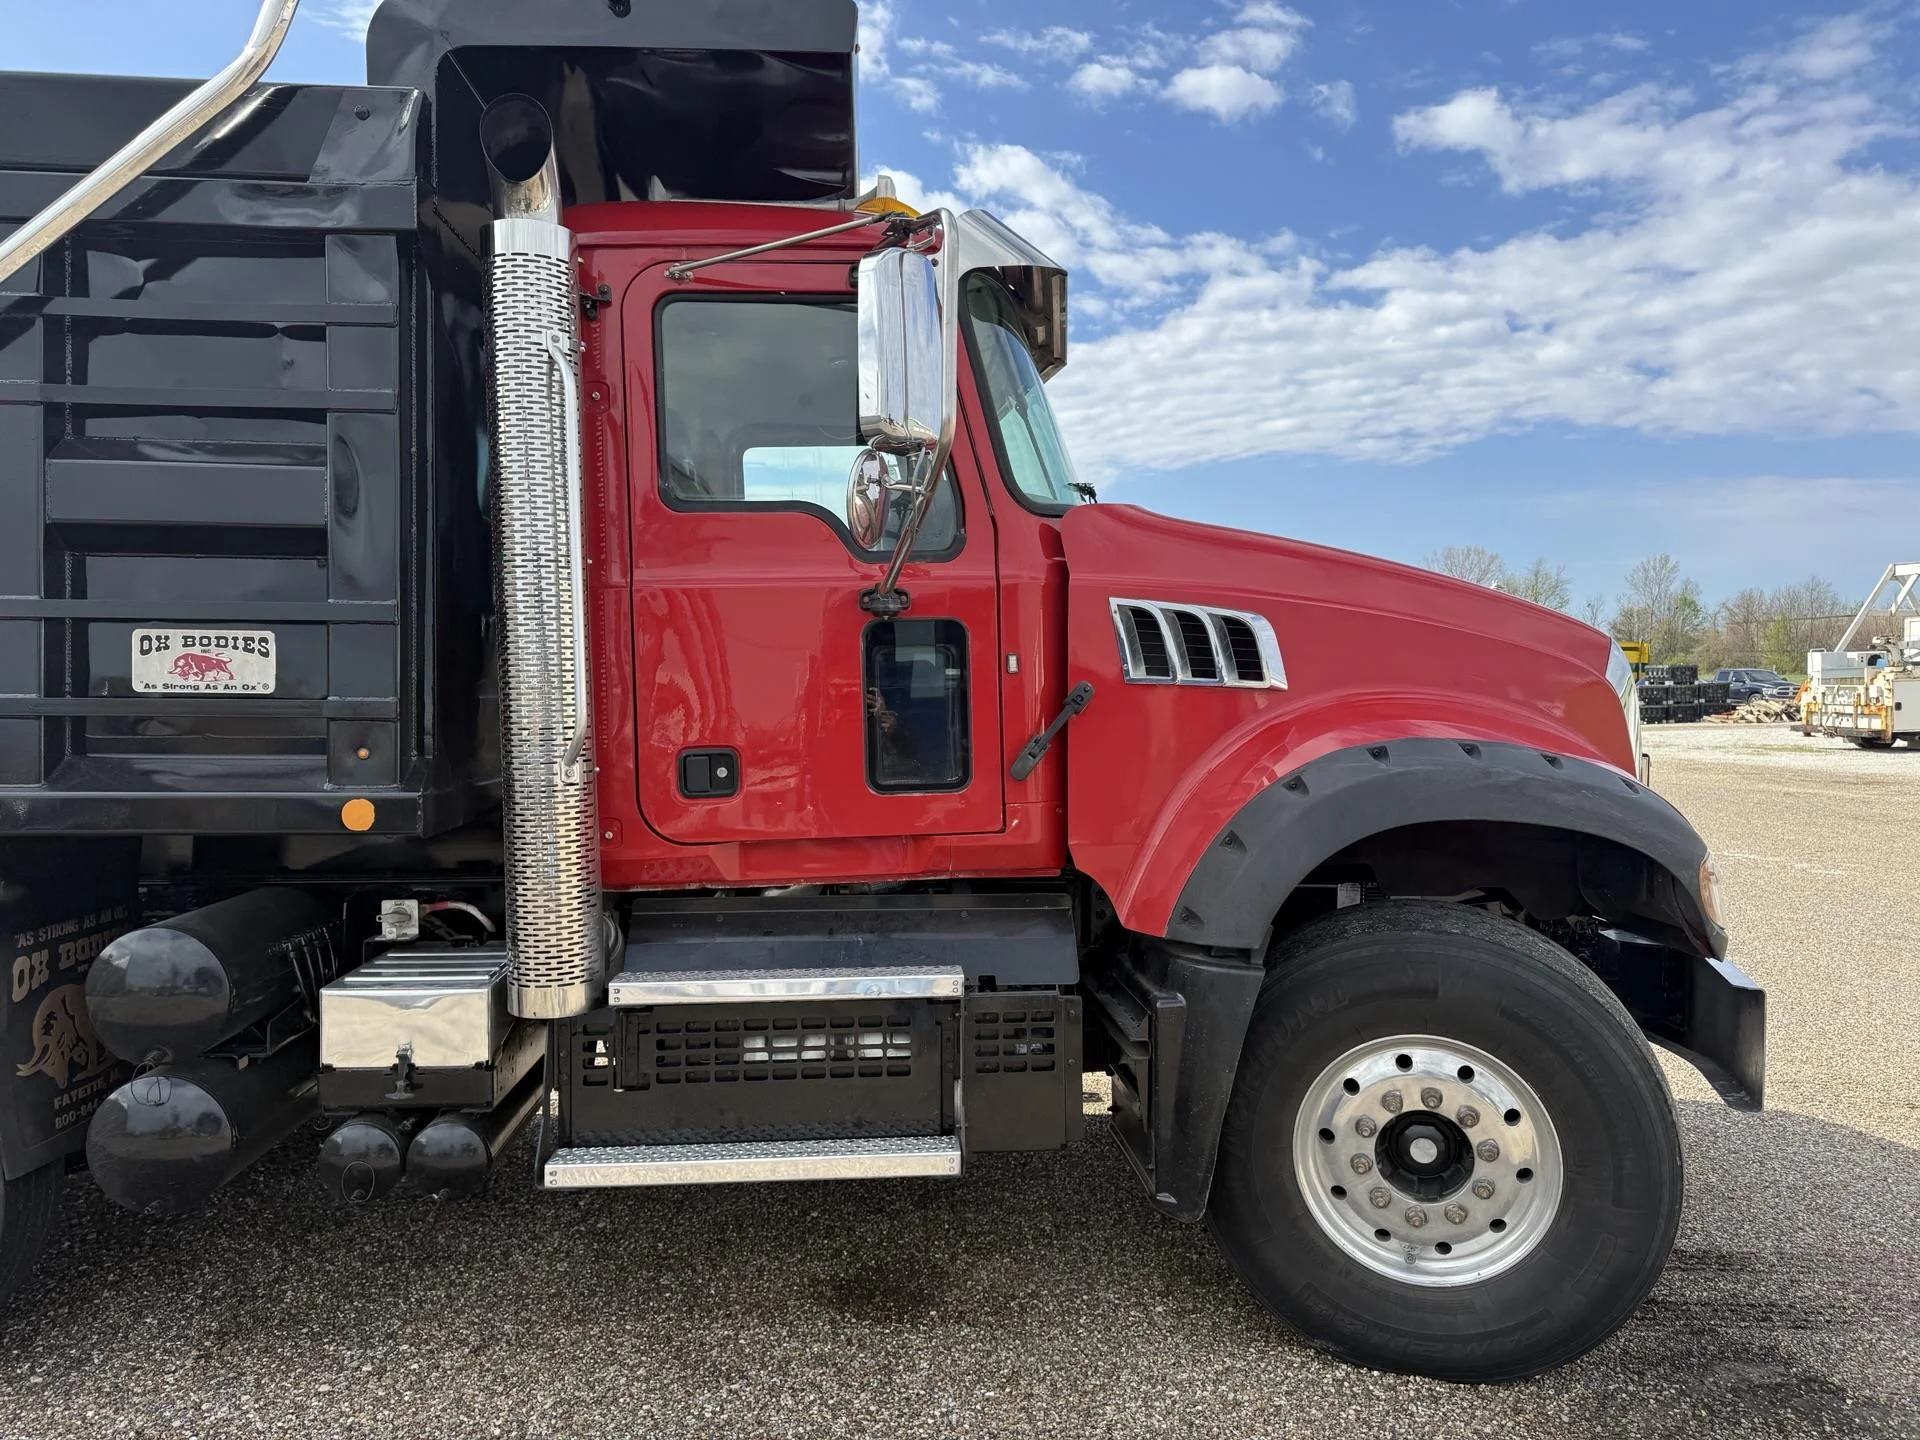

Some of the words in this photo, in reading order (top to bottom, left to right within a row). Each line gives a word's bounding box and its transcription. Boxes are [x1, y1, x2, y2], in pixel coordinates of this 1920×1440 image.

[139, 634, 171, 657] OX
[181, 635, 271, 658] BODIES
[162, 683, 200, 691] Strong
[222, 683, 238, 691] An
[39, 918, 80, 943] STRONG
[11, 949, 50, 1004] OX
